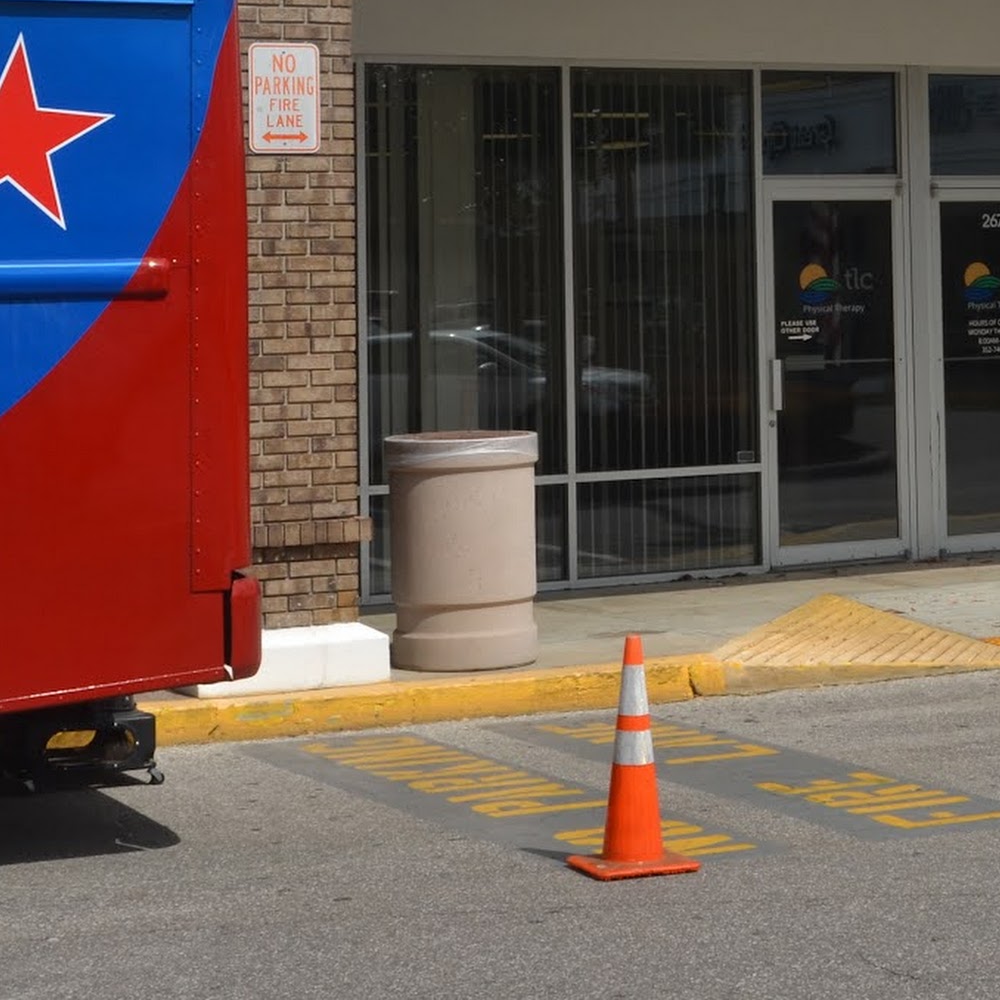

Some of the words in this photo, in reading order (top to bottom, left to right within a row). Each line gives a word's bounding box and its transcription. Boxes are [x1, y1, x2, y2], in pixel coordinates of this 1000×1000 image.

[272, 54, 296, 73] NO
[255, 76, 314, 95] PARKING
[270, 99, 300, 112] FIRE
[267, 115, 303, 128] LANE
[803, 304, 833, 314] Physical
[968, 302, 996, 311] Physical
[302, 736, 610, 818] PARKING
